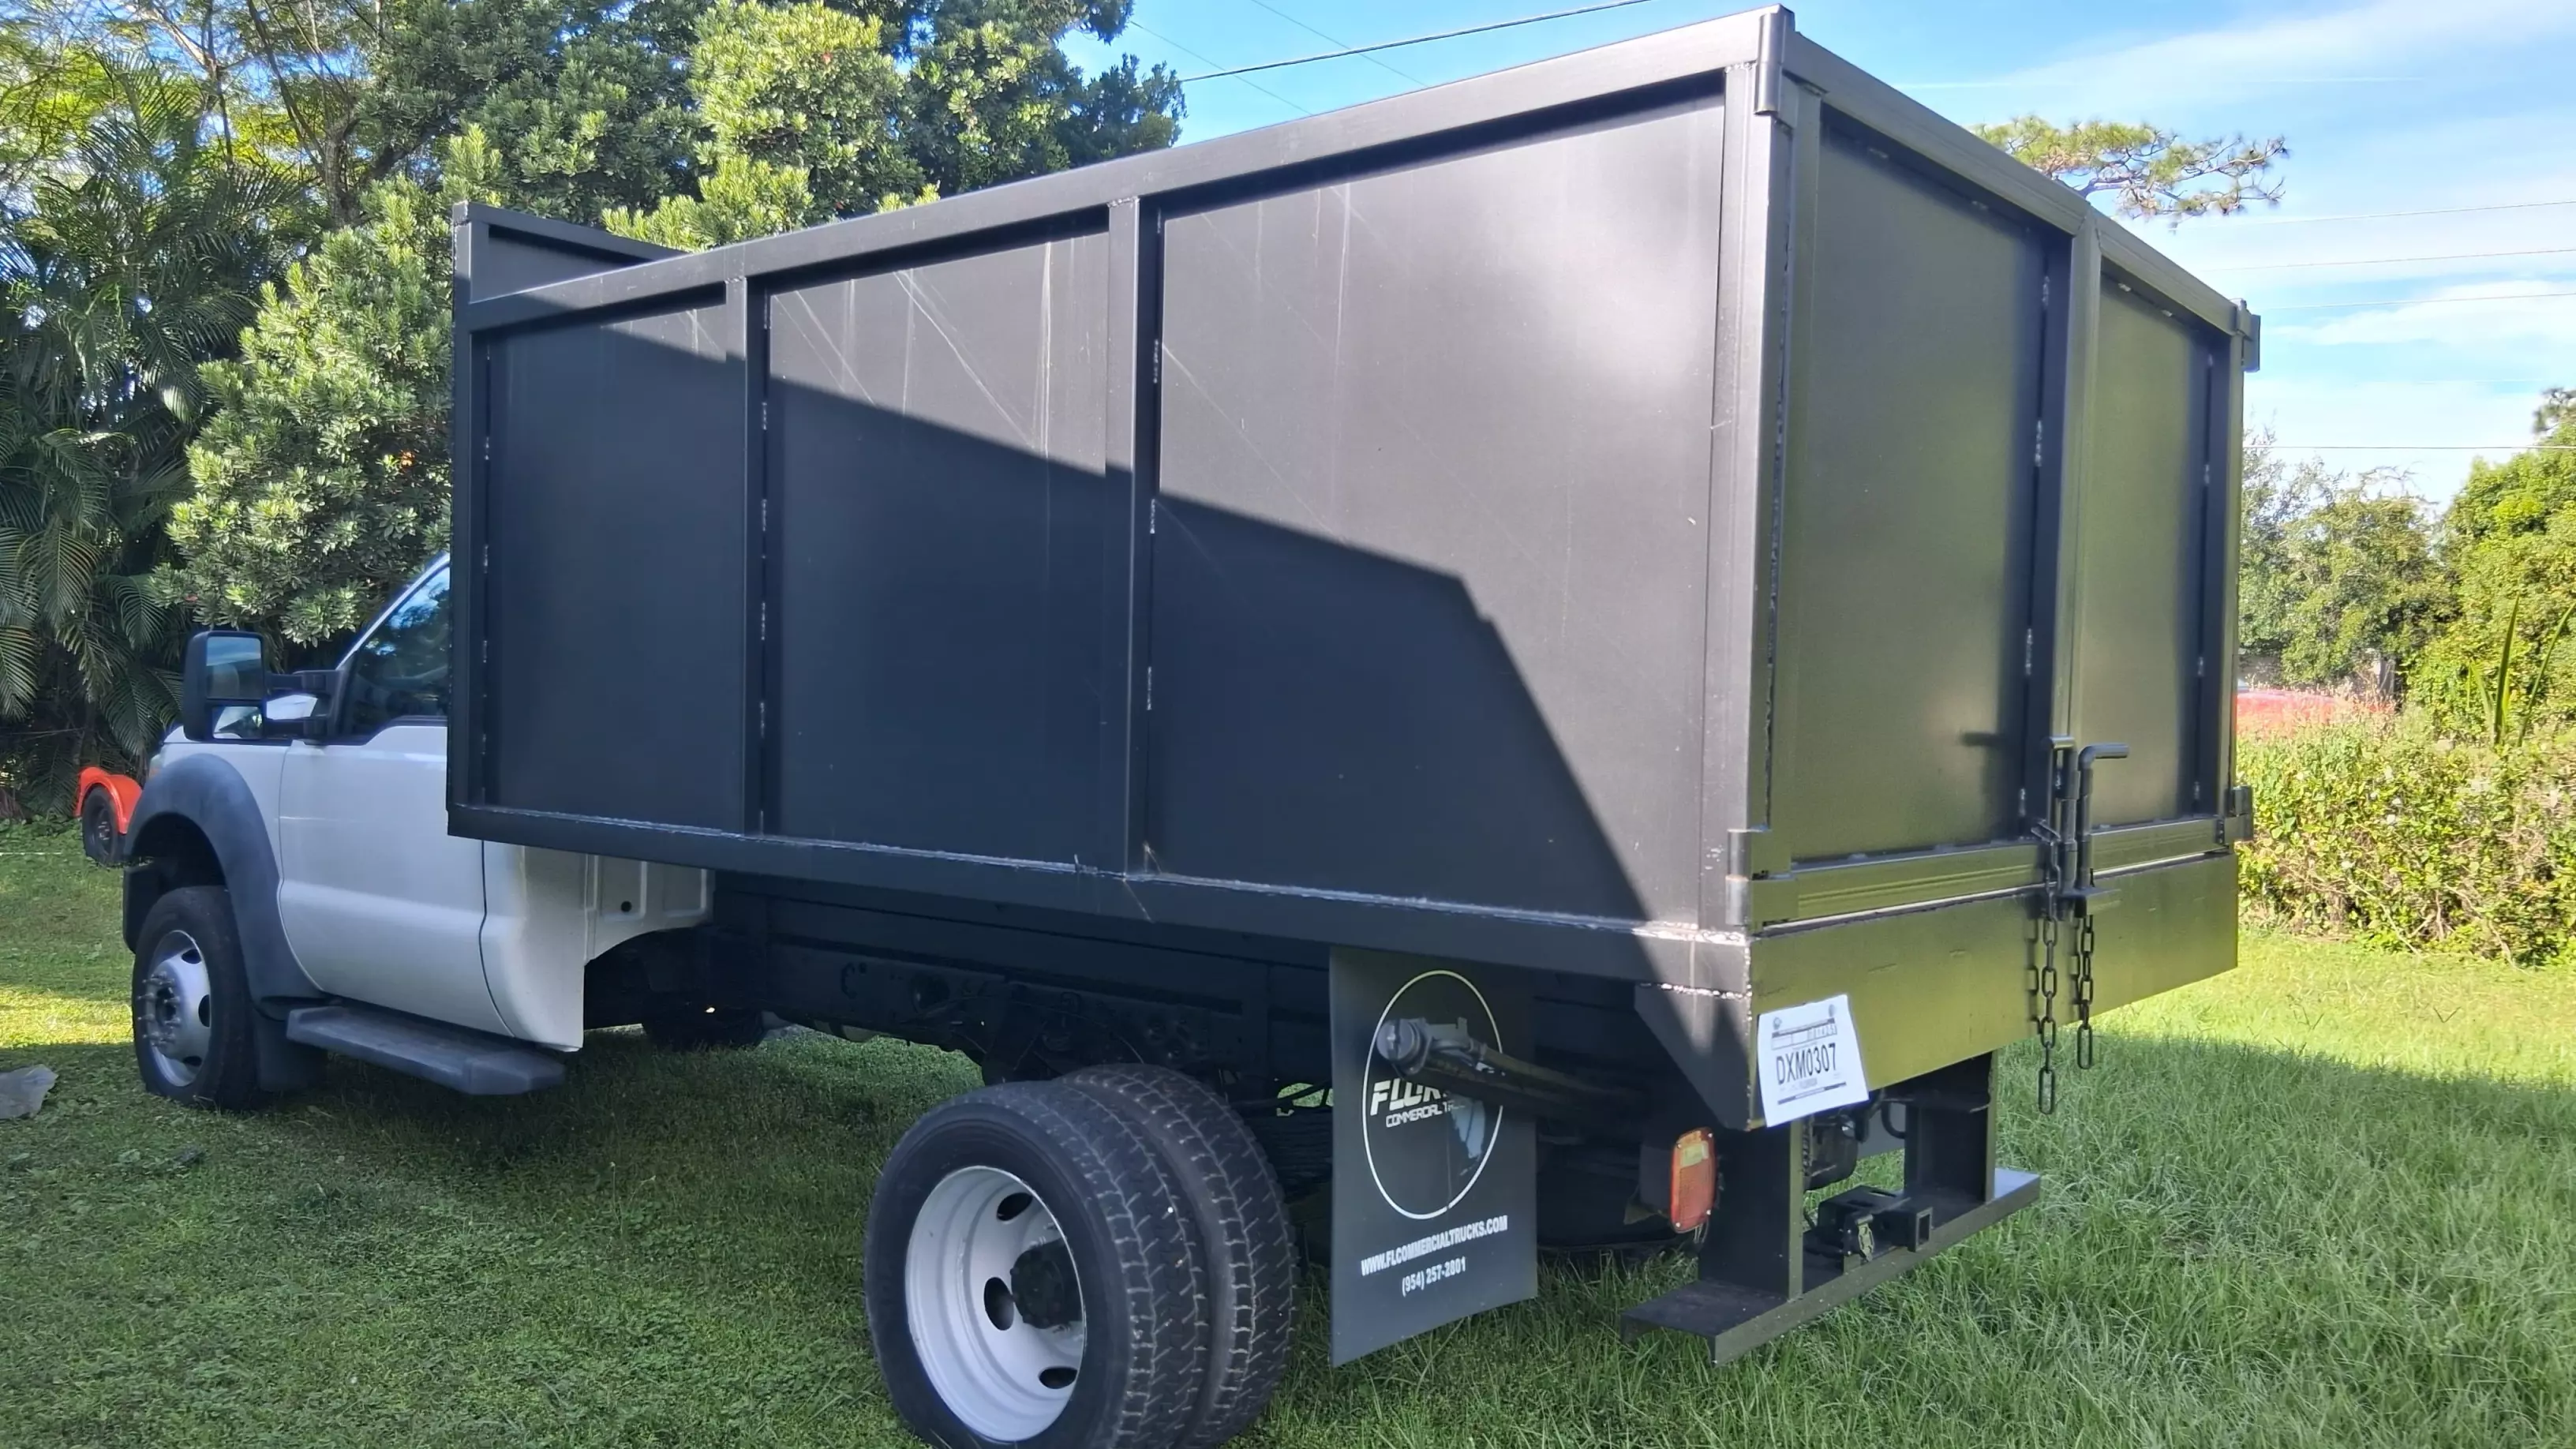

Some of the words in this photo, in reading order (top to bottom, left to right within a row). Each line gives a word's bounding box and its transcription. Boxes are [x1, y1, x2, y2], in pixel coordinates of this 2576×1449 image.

[1777, 1043, 1836, 1085] DXM0307
[1386, 1103, 1443, 1128] COMMERCIAL
[1361, 1215, 1508, 1276] WWW.FLCOMMERCIALTRUCKS.COM
[1402, 1271, 1425, 1297] (954)
[1426, 1256, 1466, 1284] 257-2801
